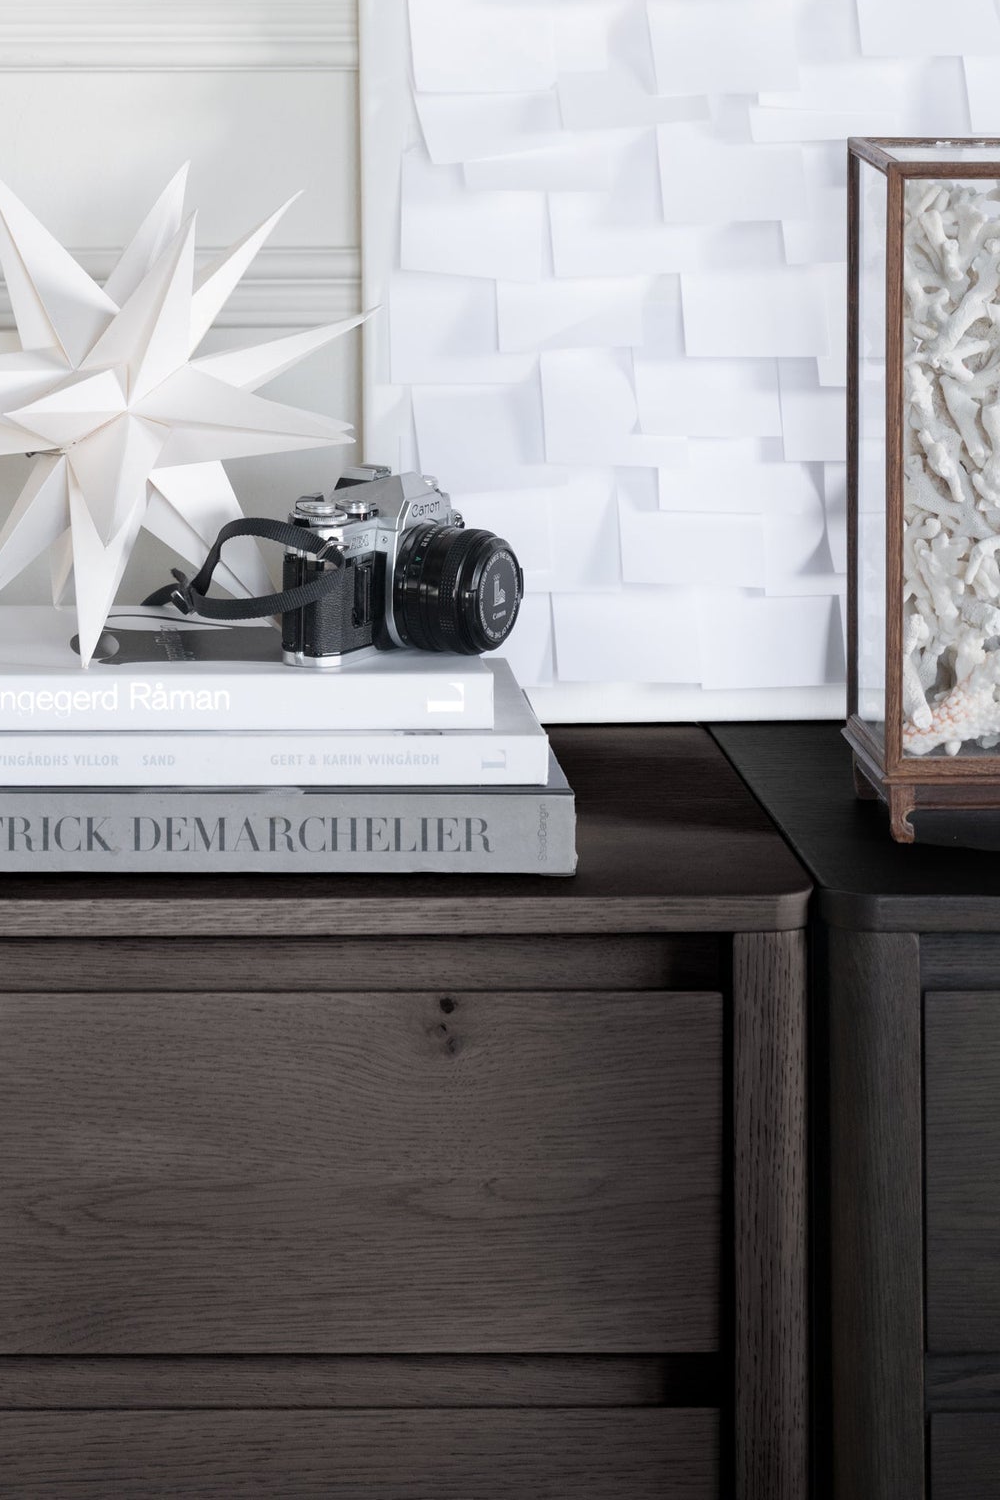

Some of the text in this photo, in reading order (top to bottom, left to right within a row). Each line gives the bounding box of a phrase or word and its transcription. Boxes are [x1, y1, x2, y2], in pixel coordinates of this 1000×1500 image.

[411, 501, 440, 518] Canon
[130, 682, 230, 712] Råman
[74, 755, 119, 767] VILLOR
[142, 755, 176, 767] SAND
[270, 750, 440, 766] GERT & KARIN WINGÅRDH
[130, 815, 495, 853] DEMARCHELIER
